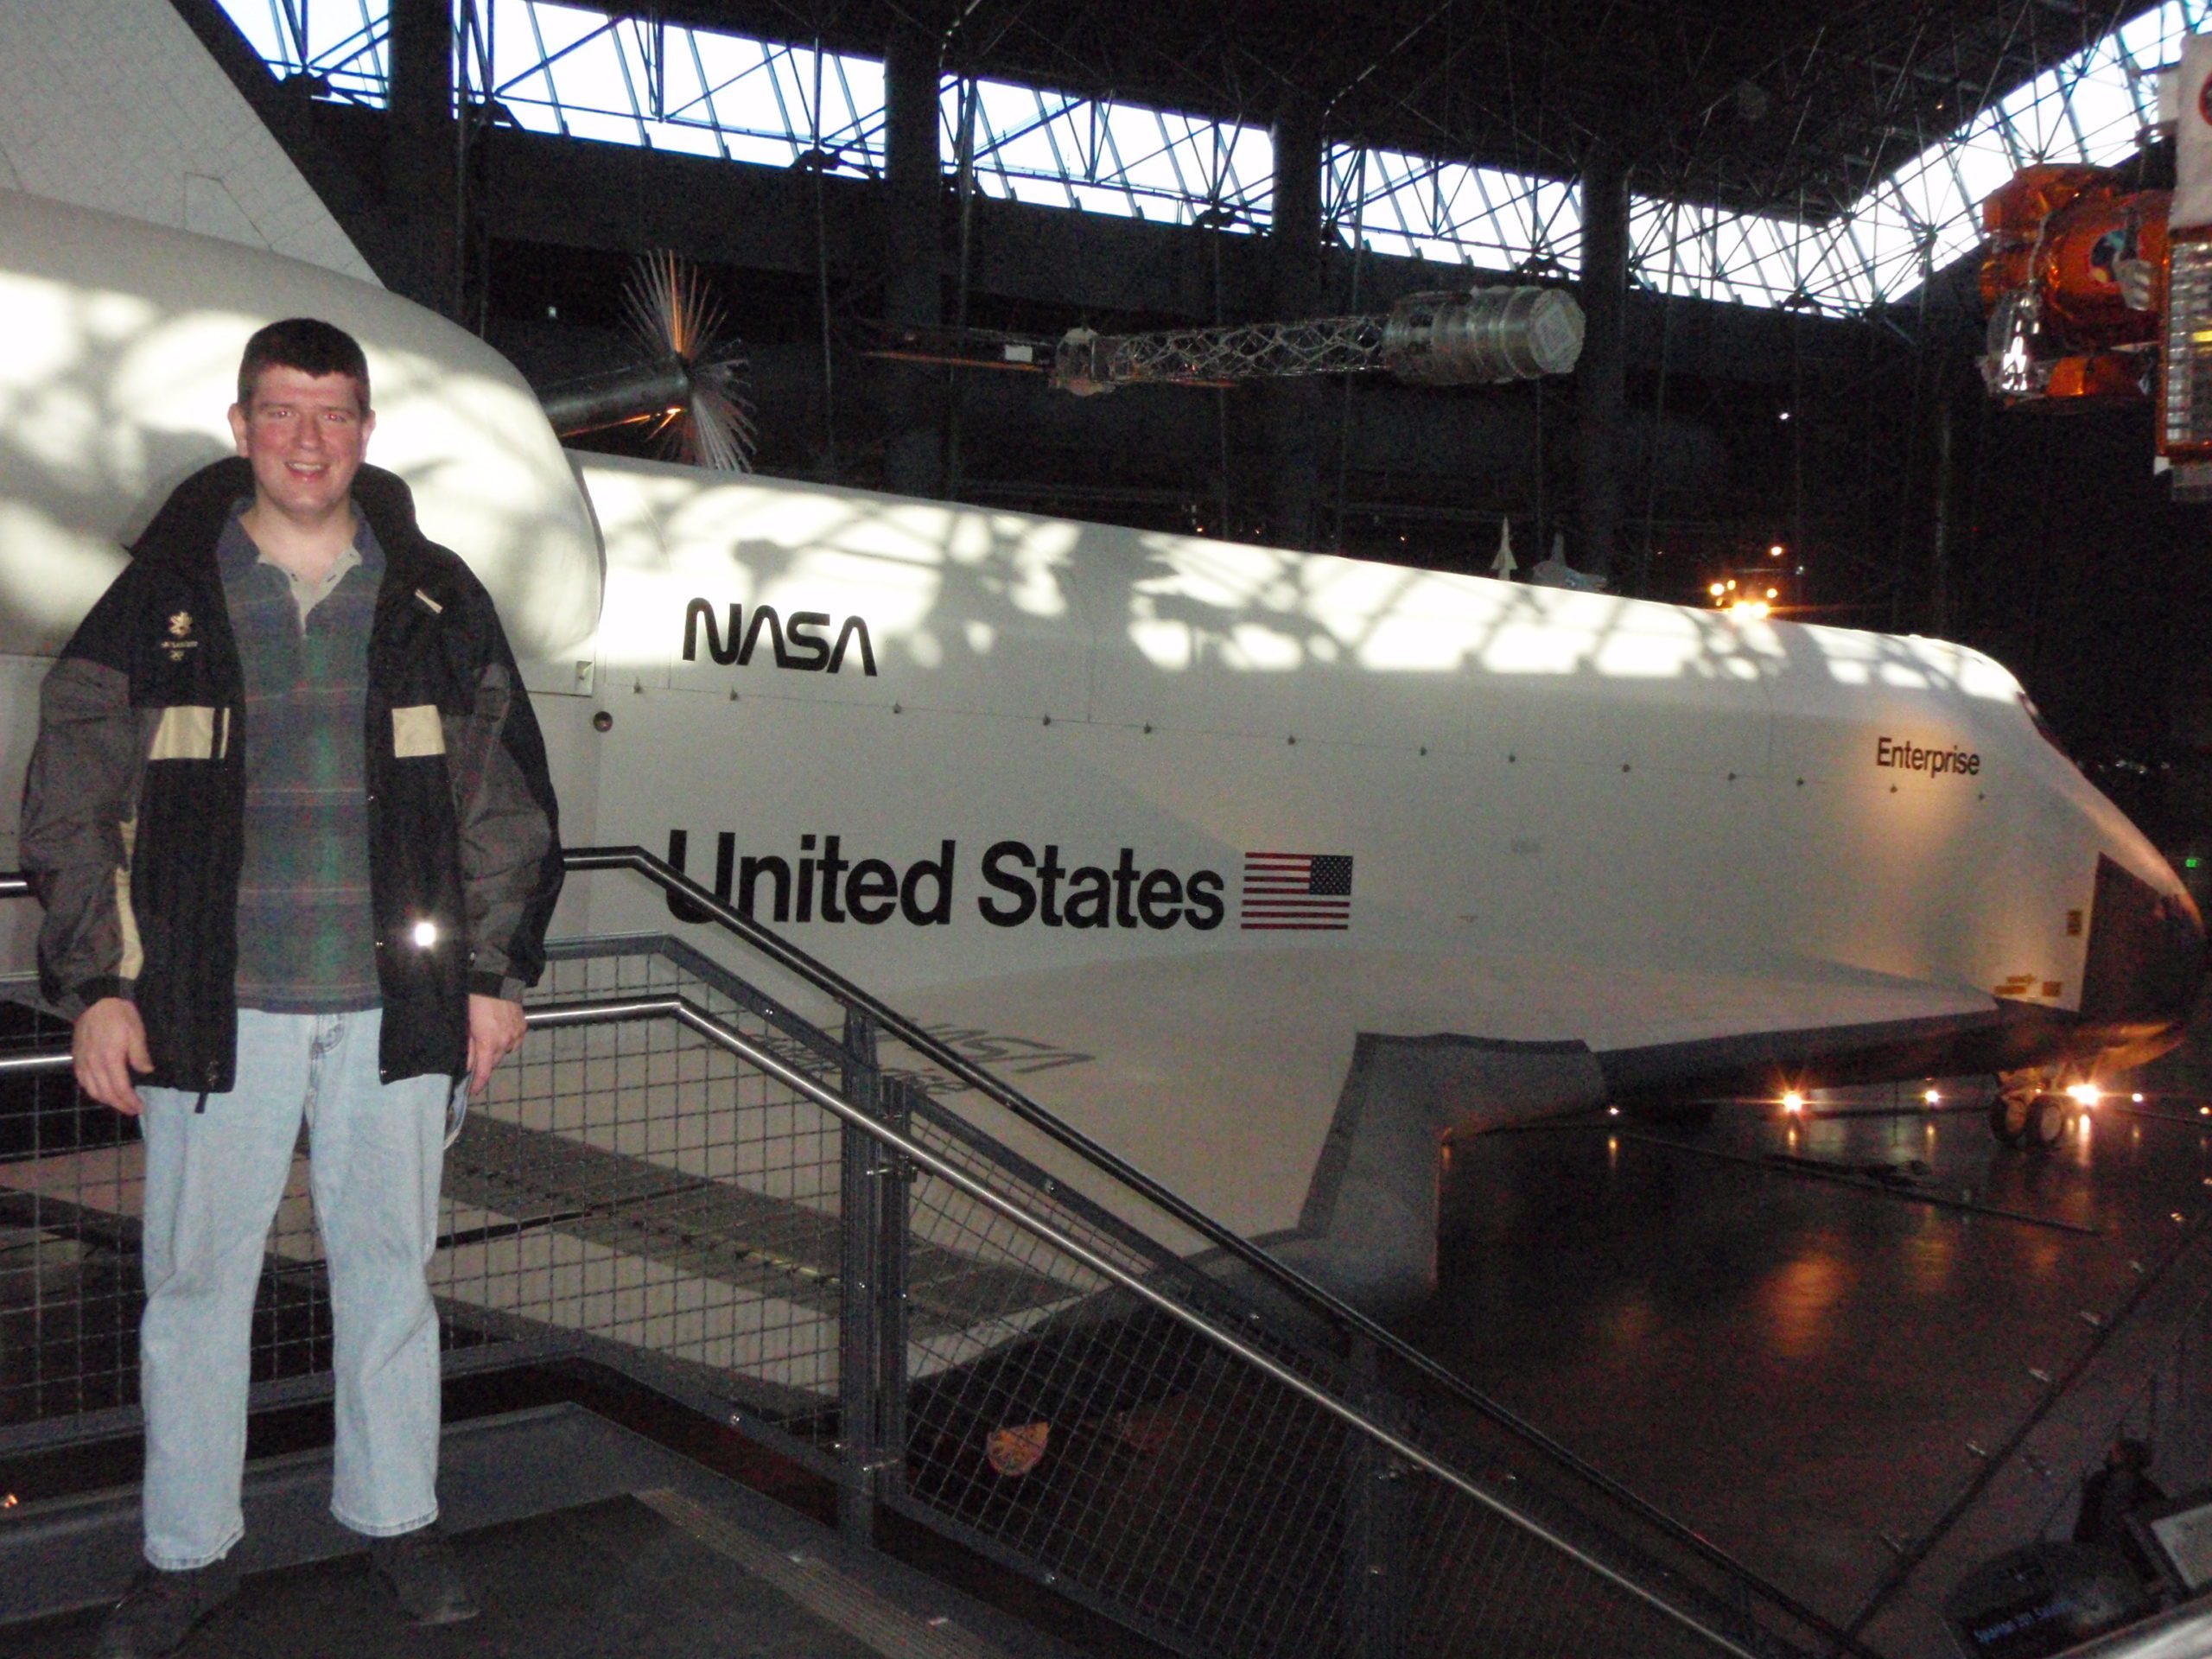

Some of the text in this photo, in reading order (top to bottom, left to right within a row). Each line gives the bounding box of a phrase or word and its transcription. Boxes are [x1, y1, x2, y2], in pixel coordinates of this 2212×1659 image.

[683, 598, 878, 676] NASA
[1876, 736, 1980, 778] Enterprise
[666, 830, 1225, 931] United States
